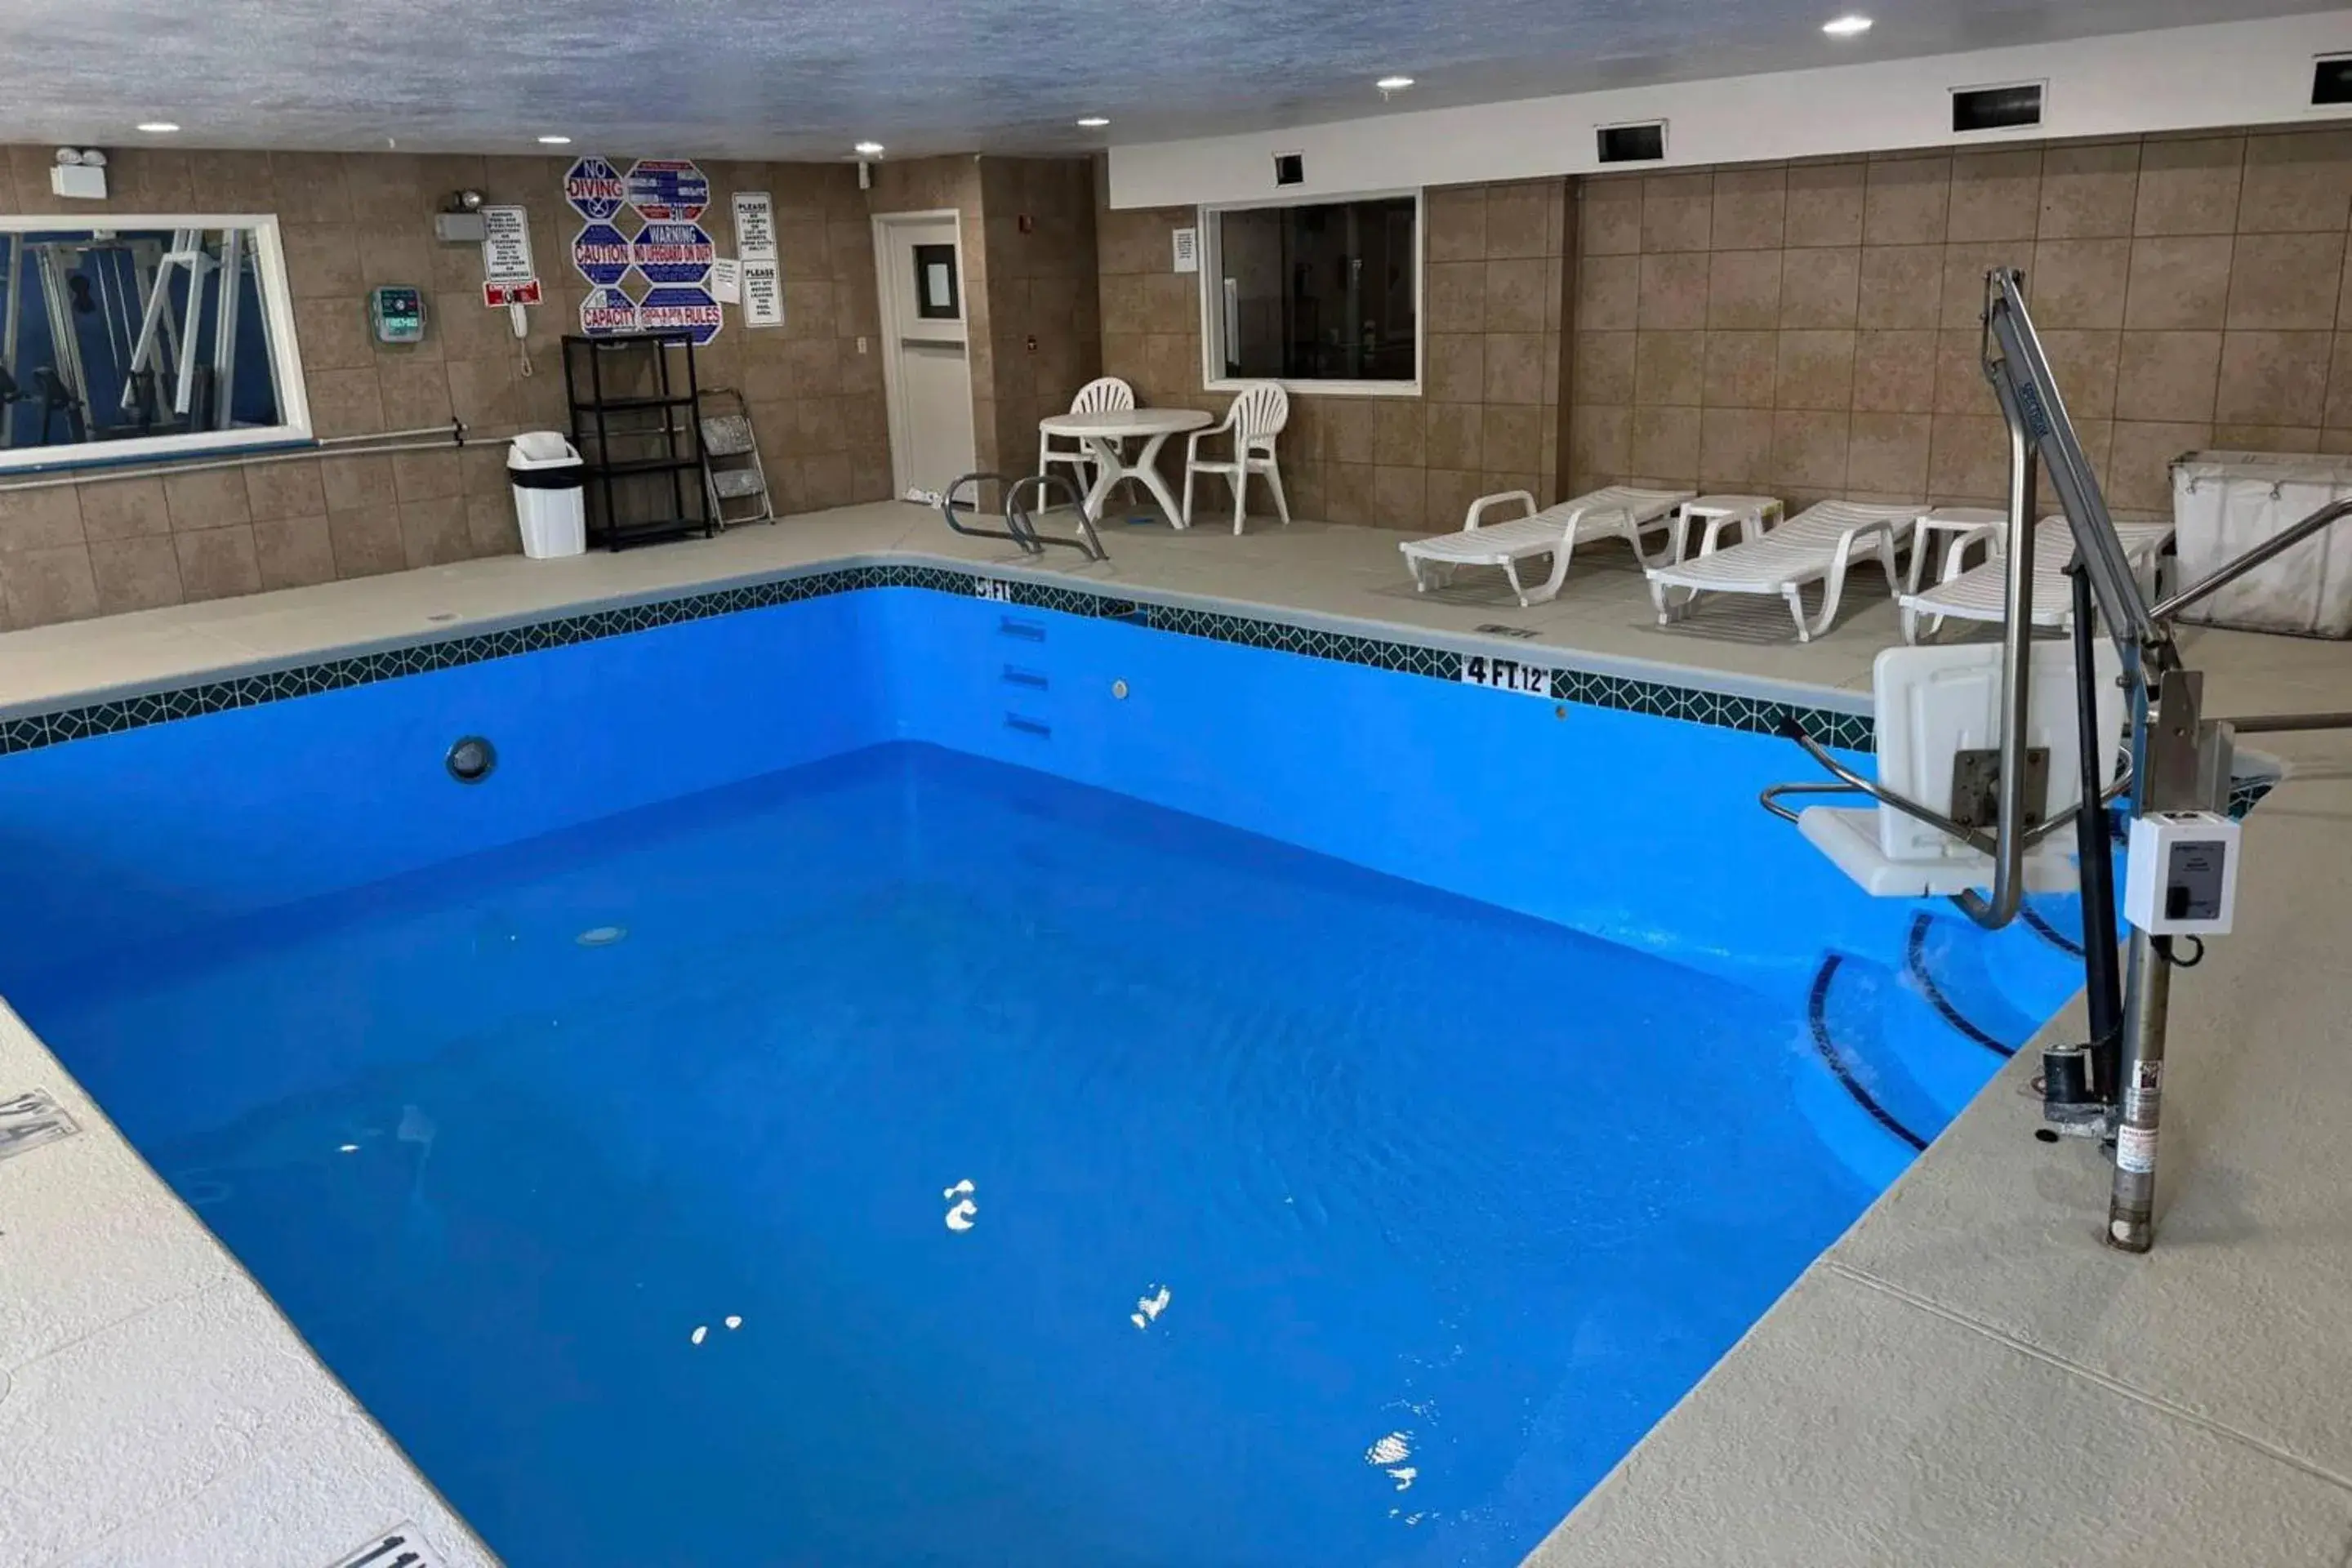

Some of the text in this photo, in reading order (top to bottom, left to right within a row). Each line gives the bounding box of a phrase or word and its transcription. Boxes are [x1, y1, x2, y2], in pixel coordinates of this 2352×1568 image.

[583, 160, 606, 178] NO
[569, 179, 623, 197] DIVING
[738, 203, 766, 211] PLEASE
[648, 225, 697, 244] WARNING
[575, 245, 629, 263] CAUTION
[746, 269, 773, 277] PLEASE
[584, 310, 635, 326] CAPACITY
[685, 307, 719, 323] RULES
[1468, 657, 1486, 684] 4
